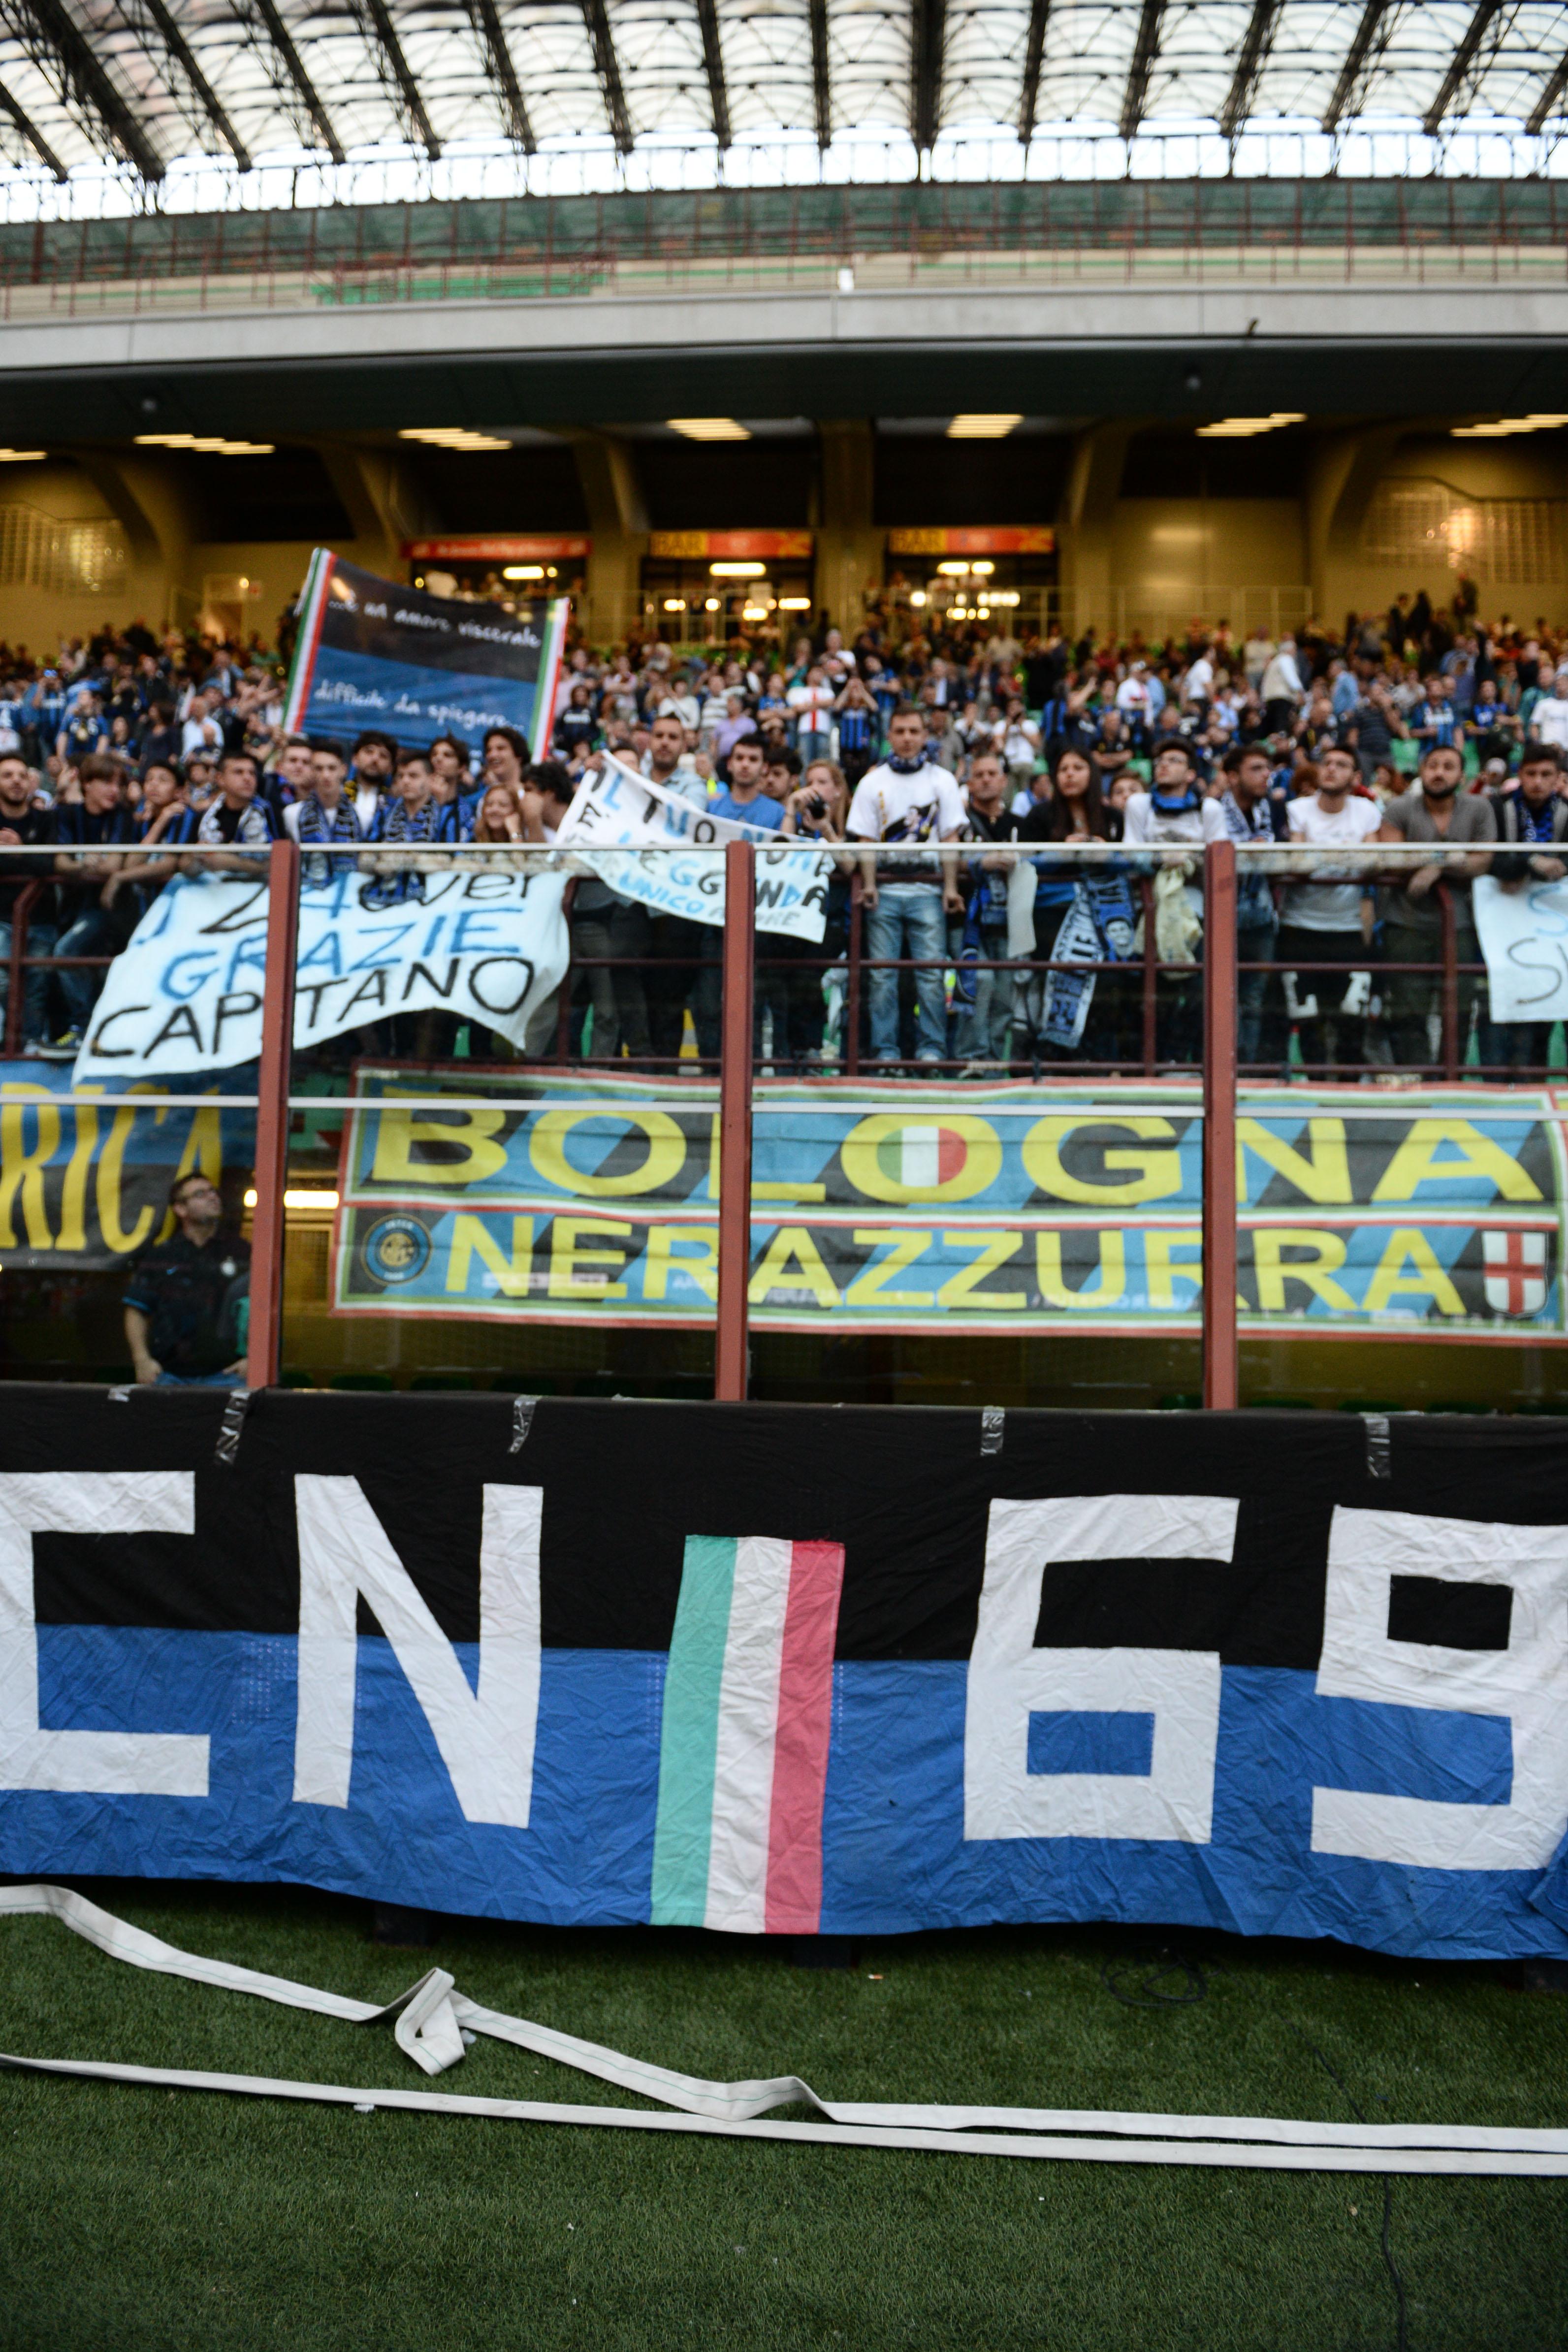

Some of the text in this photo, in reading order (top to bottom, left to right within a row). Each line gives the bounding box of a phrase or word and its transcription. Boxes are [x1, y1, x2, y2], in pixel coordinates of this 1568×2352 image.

[458, 619, 542, 648] viscerale
[394, 693, 421, 715] da
[642, 789, 718, 844] TUO
[619, 870, 704, 914] UNICO
[160, 906, 523, 1000] GRAZIE
[89, 957, 535, 1058] CAPTANO
[372, 1085, 1544, 1206] BOLOGNA
[445, 1214, 1468, 1316] NERAZZURRA
[963, 1493, 1568, 1871] 69
